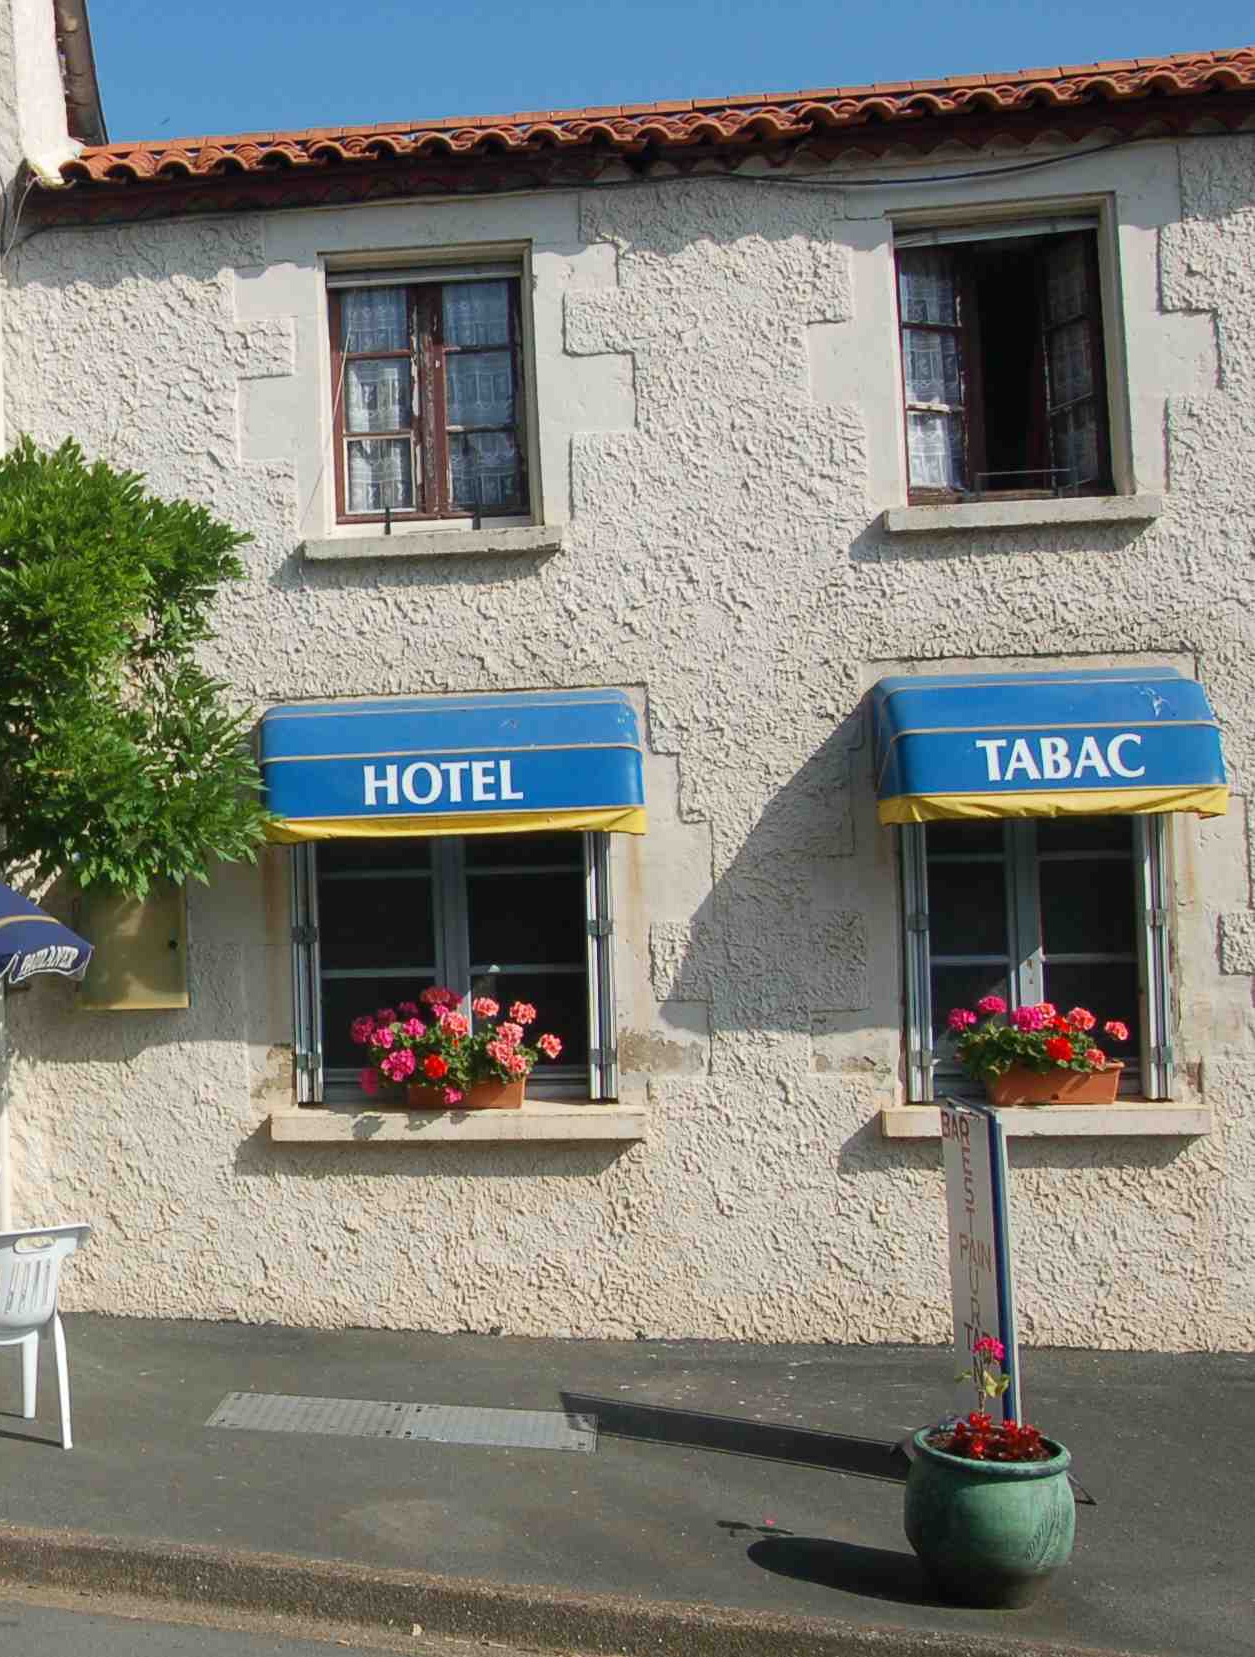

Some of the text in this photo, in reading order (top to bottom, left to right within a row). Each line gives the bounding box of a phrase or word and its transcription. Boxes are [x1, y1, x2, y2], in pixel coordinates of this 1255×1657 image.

[976, 733, 1146, 782] TABAC
[363, 759, 524, 806] HOTEL
[940, 1109, 971, 1145] BAR
